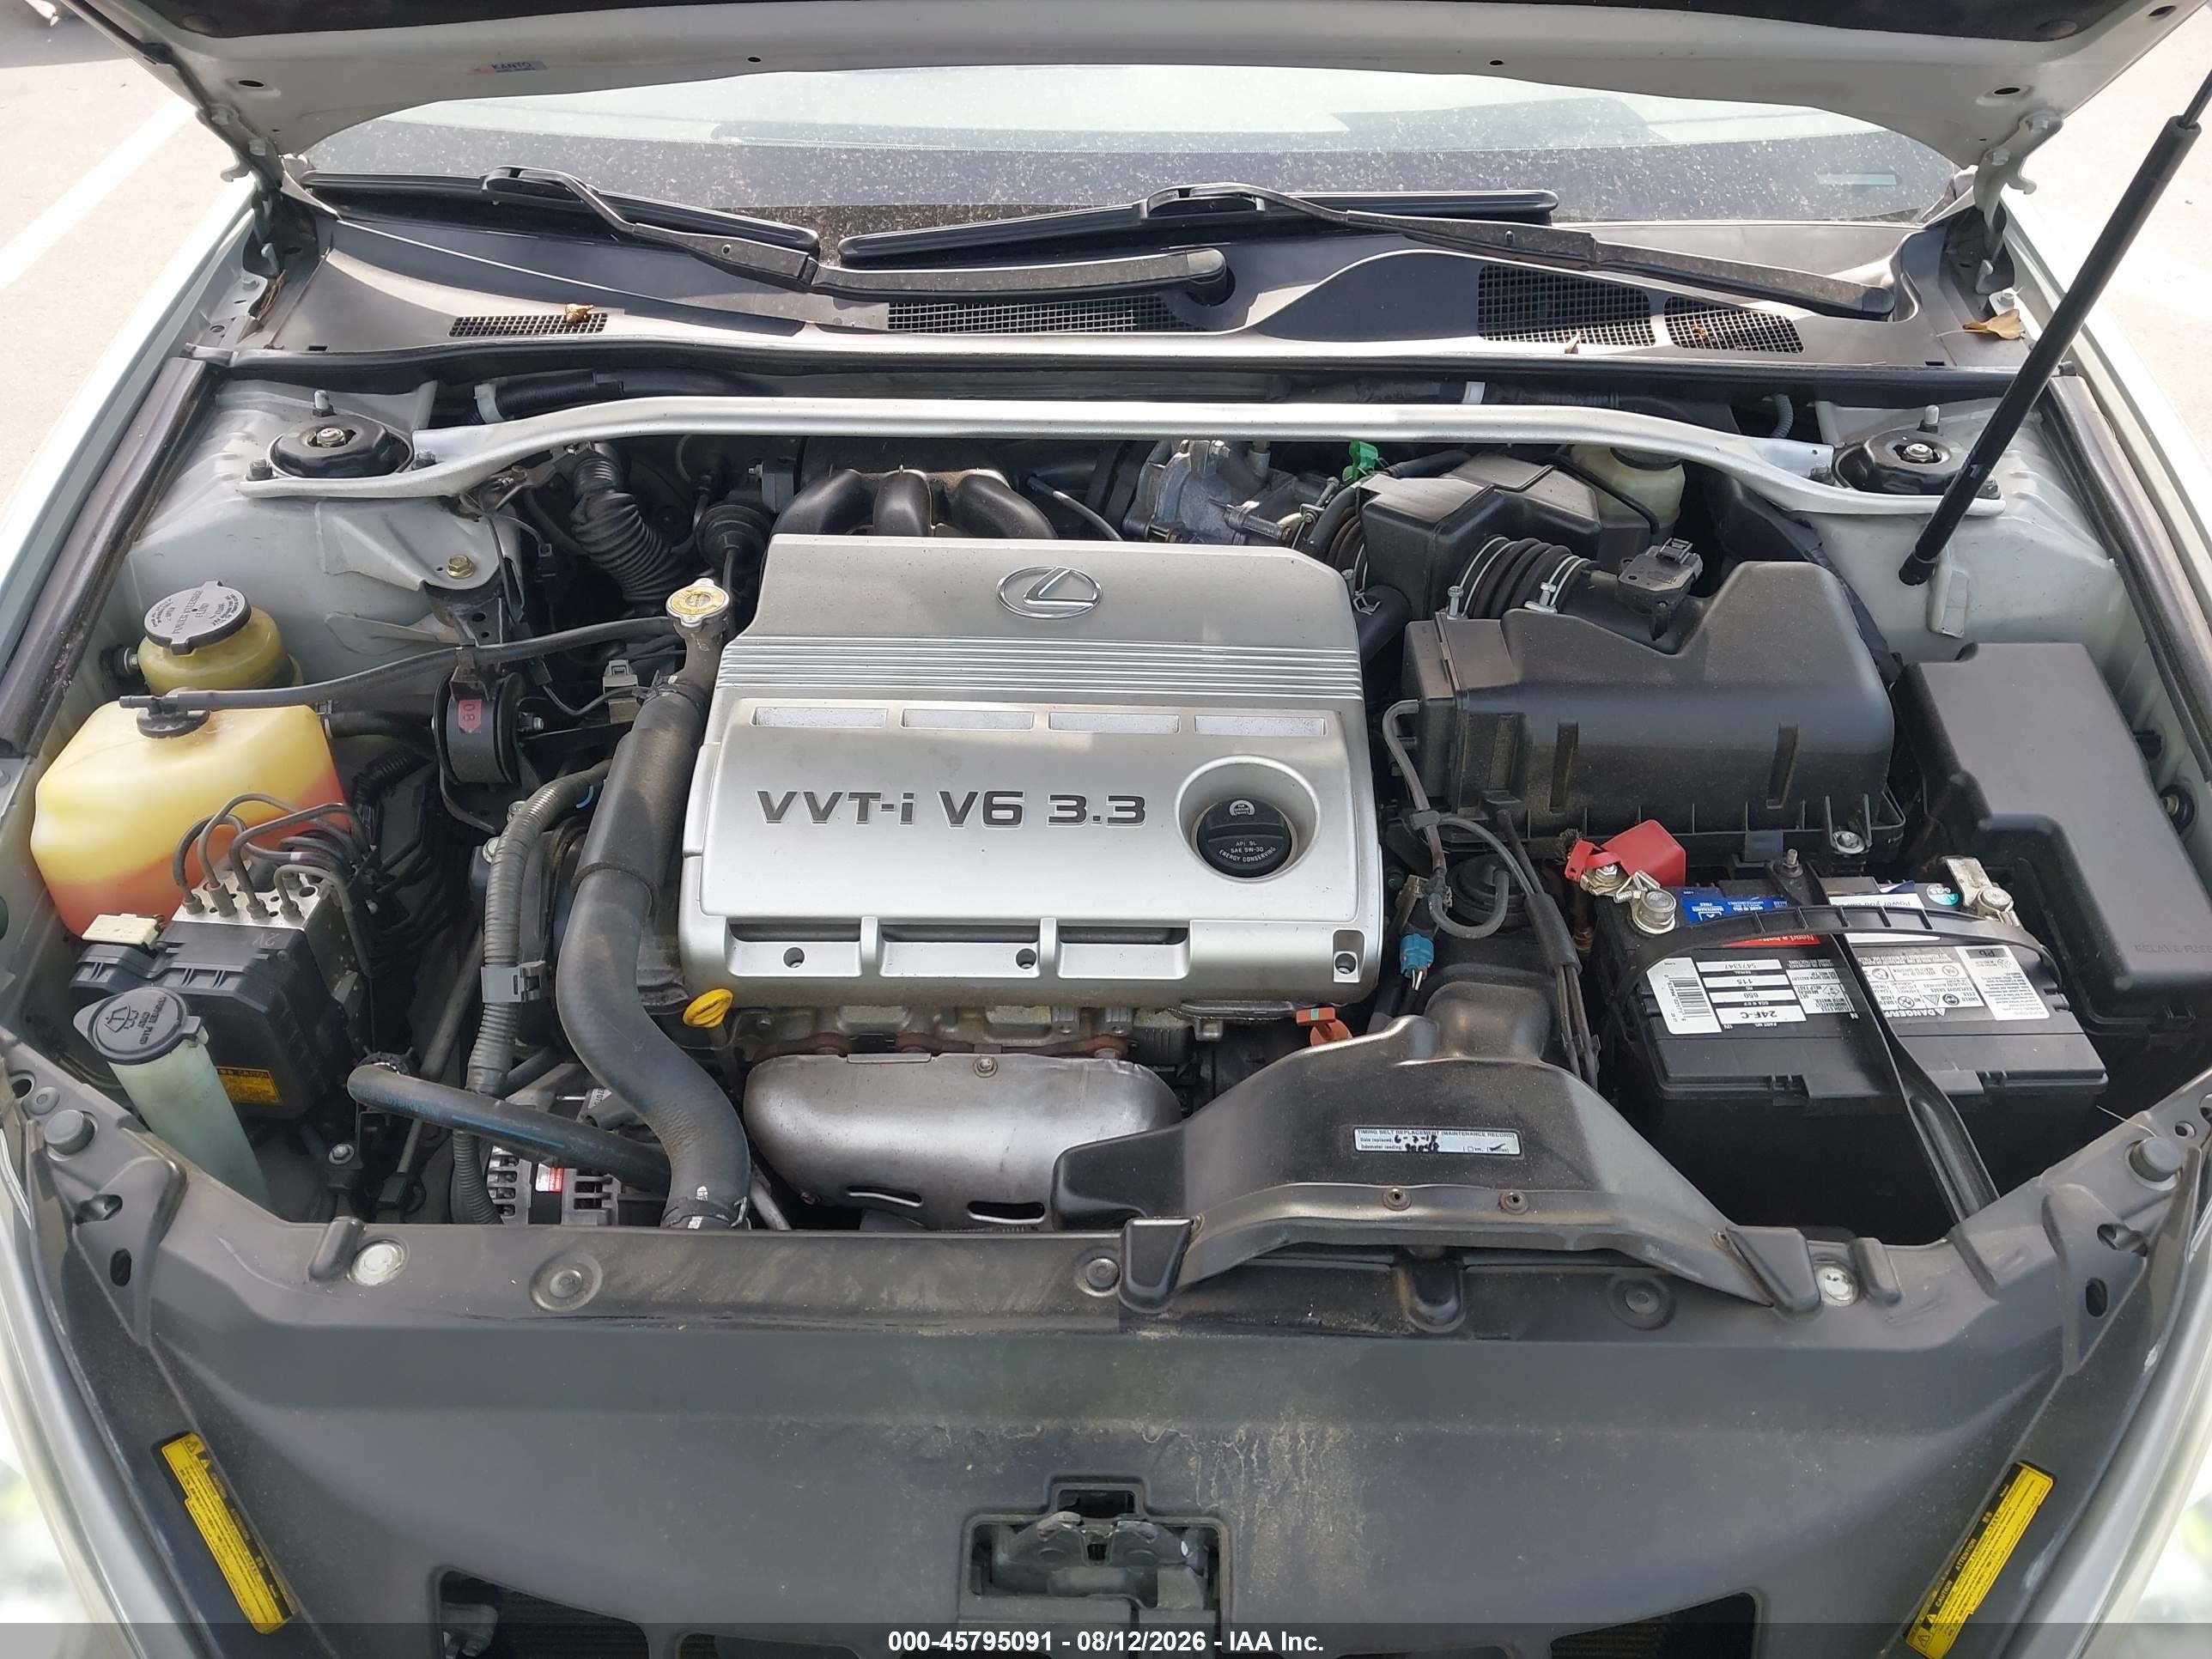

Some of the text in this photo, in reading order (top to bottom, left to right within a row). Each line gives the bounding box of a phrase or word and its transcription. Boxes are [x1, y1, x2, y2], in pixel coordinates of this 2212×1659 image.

[757, 790, 1148, 829] VVT-i V6 3.3
[1218, 847, 1277, 863] ENERGY CONSERVING
[1935, 1537, 1977, 1607] CAUTION ATTENTION
